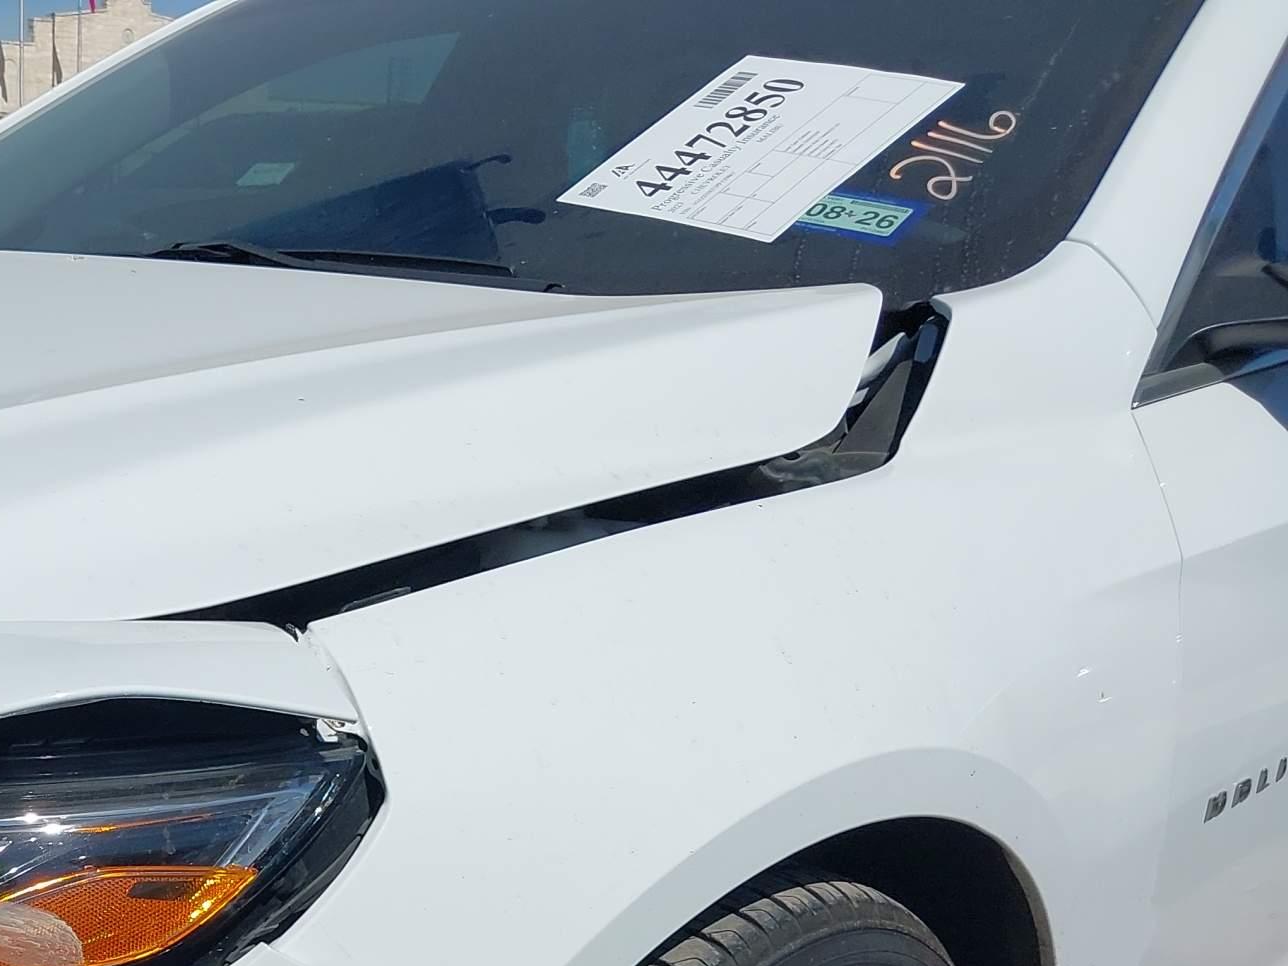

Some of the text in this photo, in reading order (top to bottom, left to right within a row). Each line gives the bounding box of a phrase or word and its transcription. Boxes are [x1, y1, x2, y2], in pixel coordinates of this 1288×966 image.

[635, 78, 806, 198] 44472850
[651, 172, 705, 212] Progressive
[700, 142, 743, 175] Casualty
[737, 114, 781, 146] Insurance
[855, 211, 899, 229] 26
